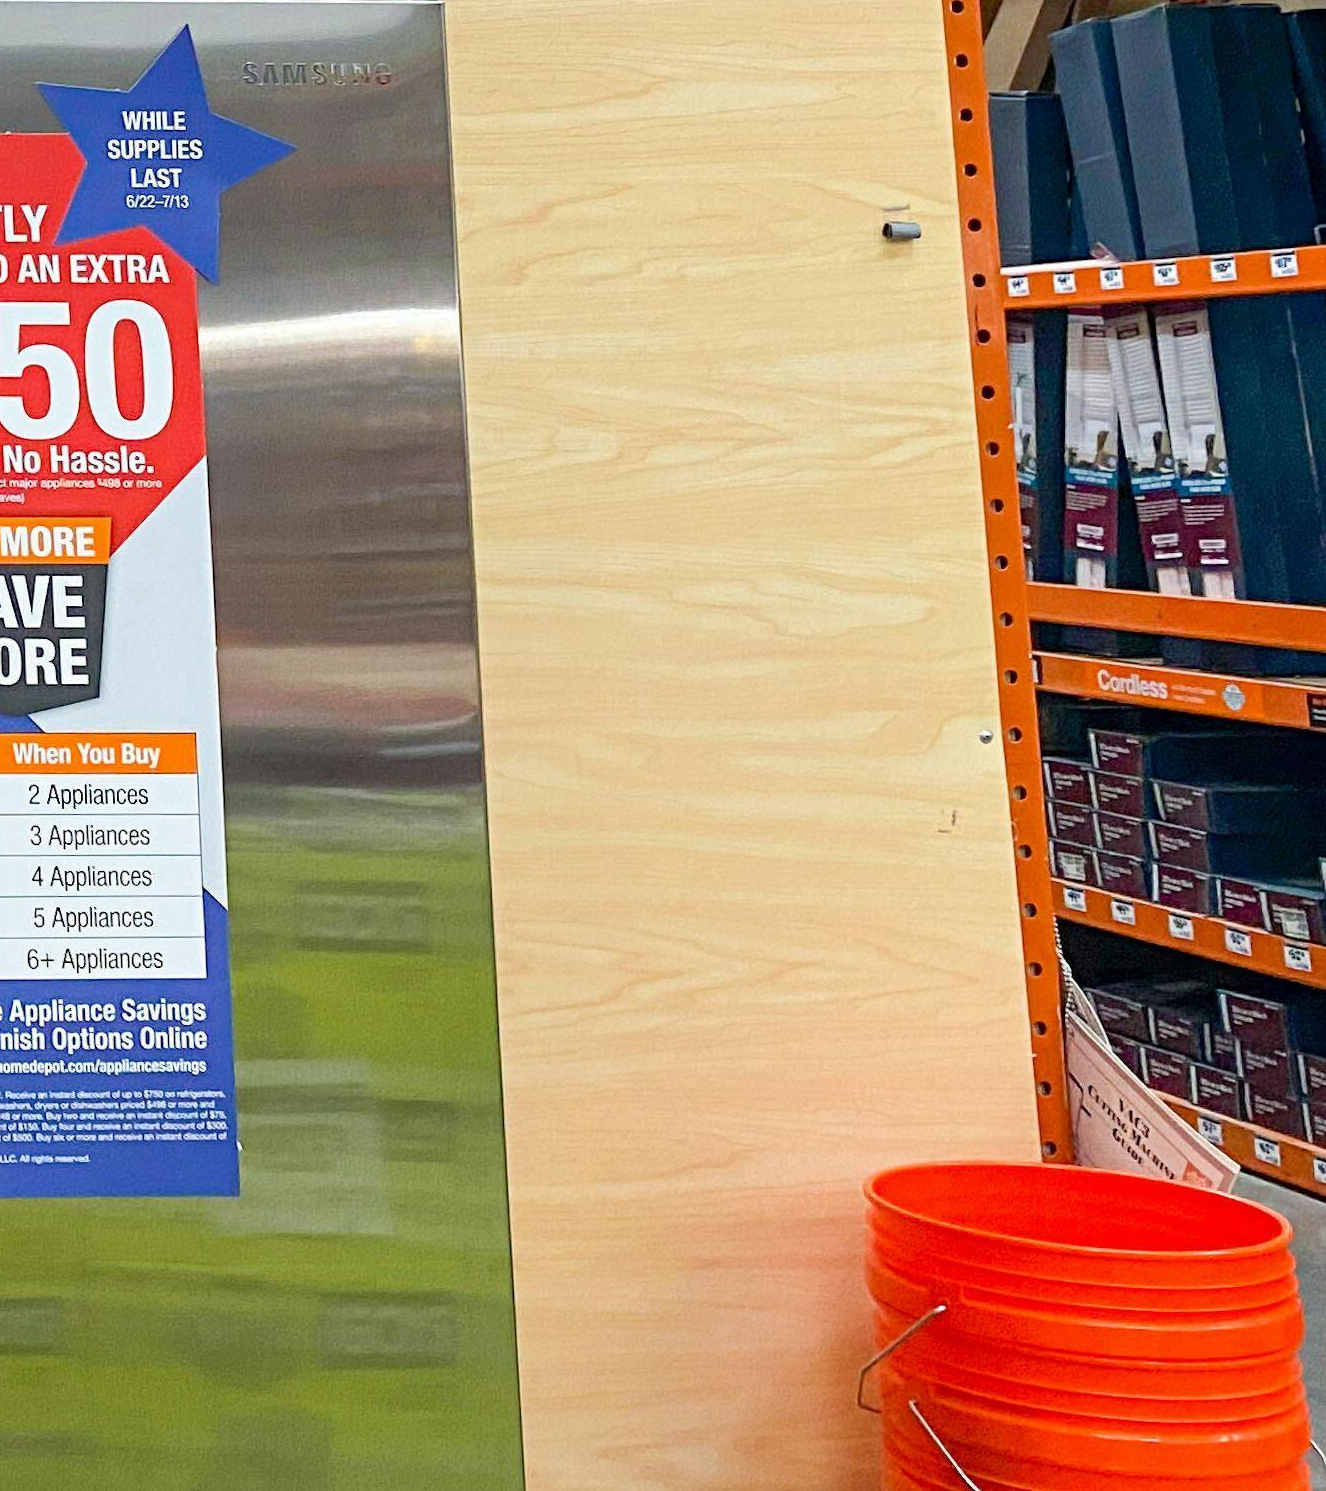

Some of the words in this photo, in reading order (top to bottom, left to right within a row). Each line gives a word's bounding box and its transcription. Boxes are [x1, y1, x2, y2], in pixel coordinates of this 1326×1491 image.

[242, 61, 392, 86] SAMSUNG
[121, 110, 187, 132] WHILE
[107, 139, 204, 161] SUPPLIES
[130, 168, 182, 189] LAST
[18, 254, 61, 283] AN
[69, 254, 170, 284] EXTRA
[2, 444, 42, 474] No
[49, 444, 155, 474] Hassle.
[8, 478, 38, 490] major
[40, 477, 95, 490] appliances
[122, 480, 134, 488] or
[136, 479, 163, 488] more
[0, 525, 96, 557] MORE
[1097, 668, 1169, 699] Cordless
[12, 743, 72, 764] When
[78, 743, 116, 764] You
[122, 743, 160, 768] Buy
[28, 784, 41, 805] 2
[47, 784, 149, 809] Appliances
[30, 825, 42, 846] 3
[48, 825, 150, 850] Appliances
[31, 866, 44, 887] 4
[50, 866, 153, 891] Appliances
[33, 907, 46, 928] 5
[52, 907, 154, 932] Appliances
[27, 948, 55, 969] 6+
[61, 948, 164, 973] Appliances
[9, 998, 116, 1026] Appliance
[121, 998, 207, 1026] Savings
[51, 1027, 134, 1054] Options
[139, 1026, 208, 1050] Online
[4, 1091, 36, 1100] Receive
[38, 1092, 48, 1100] an
[49, 1090, 75, 1099] instant
[77, 1090, 110, 1099] discount
[111, 1090, 120, 1099] of
[122, 1092, 133, 1100] up
